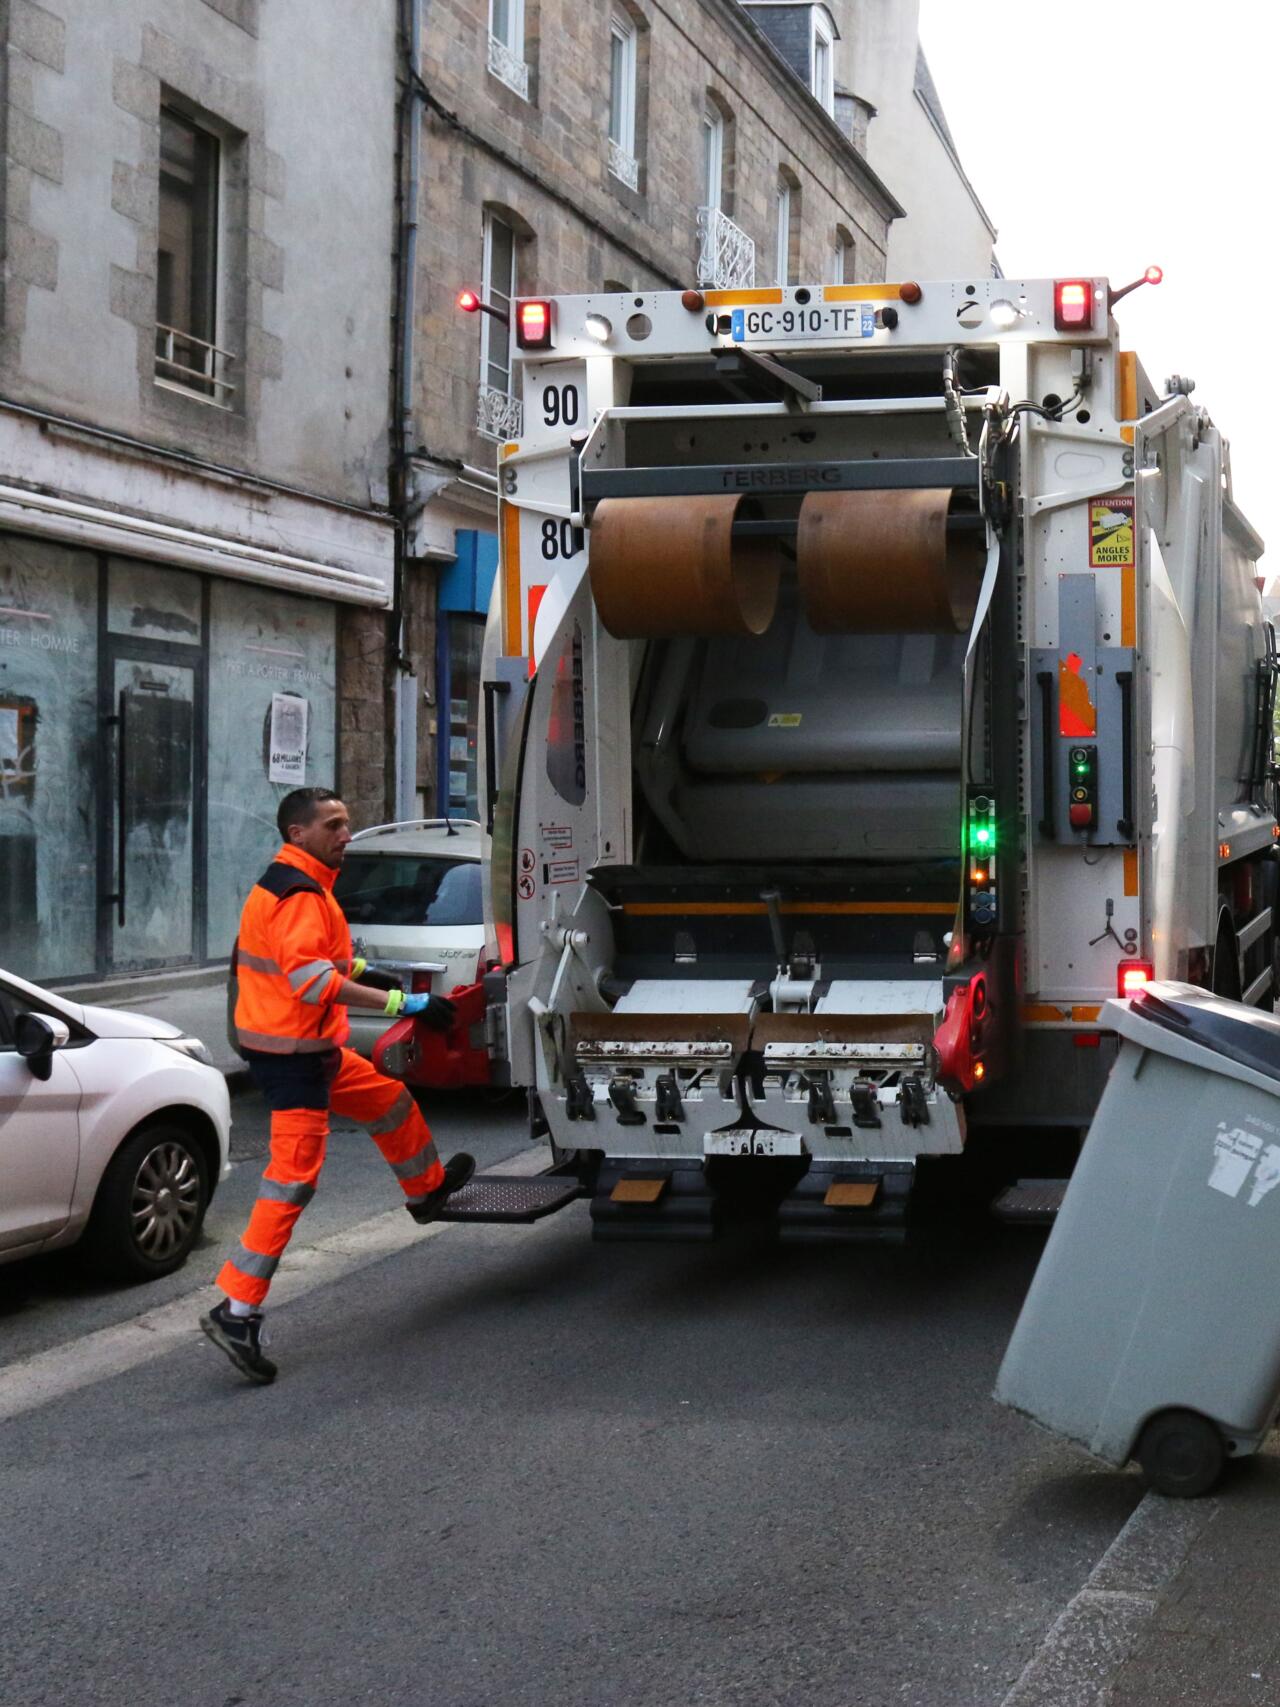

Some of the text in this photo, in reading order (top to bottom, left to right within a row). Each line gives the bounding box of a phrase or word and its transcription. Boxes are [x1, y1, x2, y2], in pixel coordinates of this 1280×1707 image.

[747, 308, 856, 334] GC-910-TF
[862, 320, 873, 331] 22
[543, 385, 578, 427] 90
[721, 467, 842, 488] TERBERG
[1092, 499, 1133, 507] ATTENTION
[541, 519, 572, 560] 80
[1096, 546, 1130, 555] ANGLES
[1097, 554, 1128, 563] MORTS
[30, 632, 81, 654] HOMME
